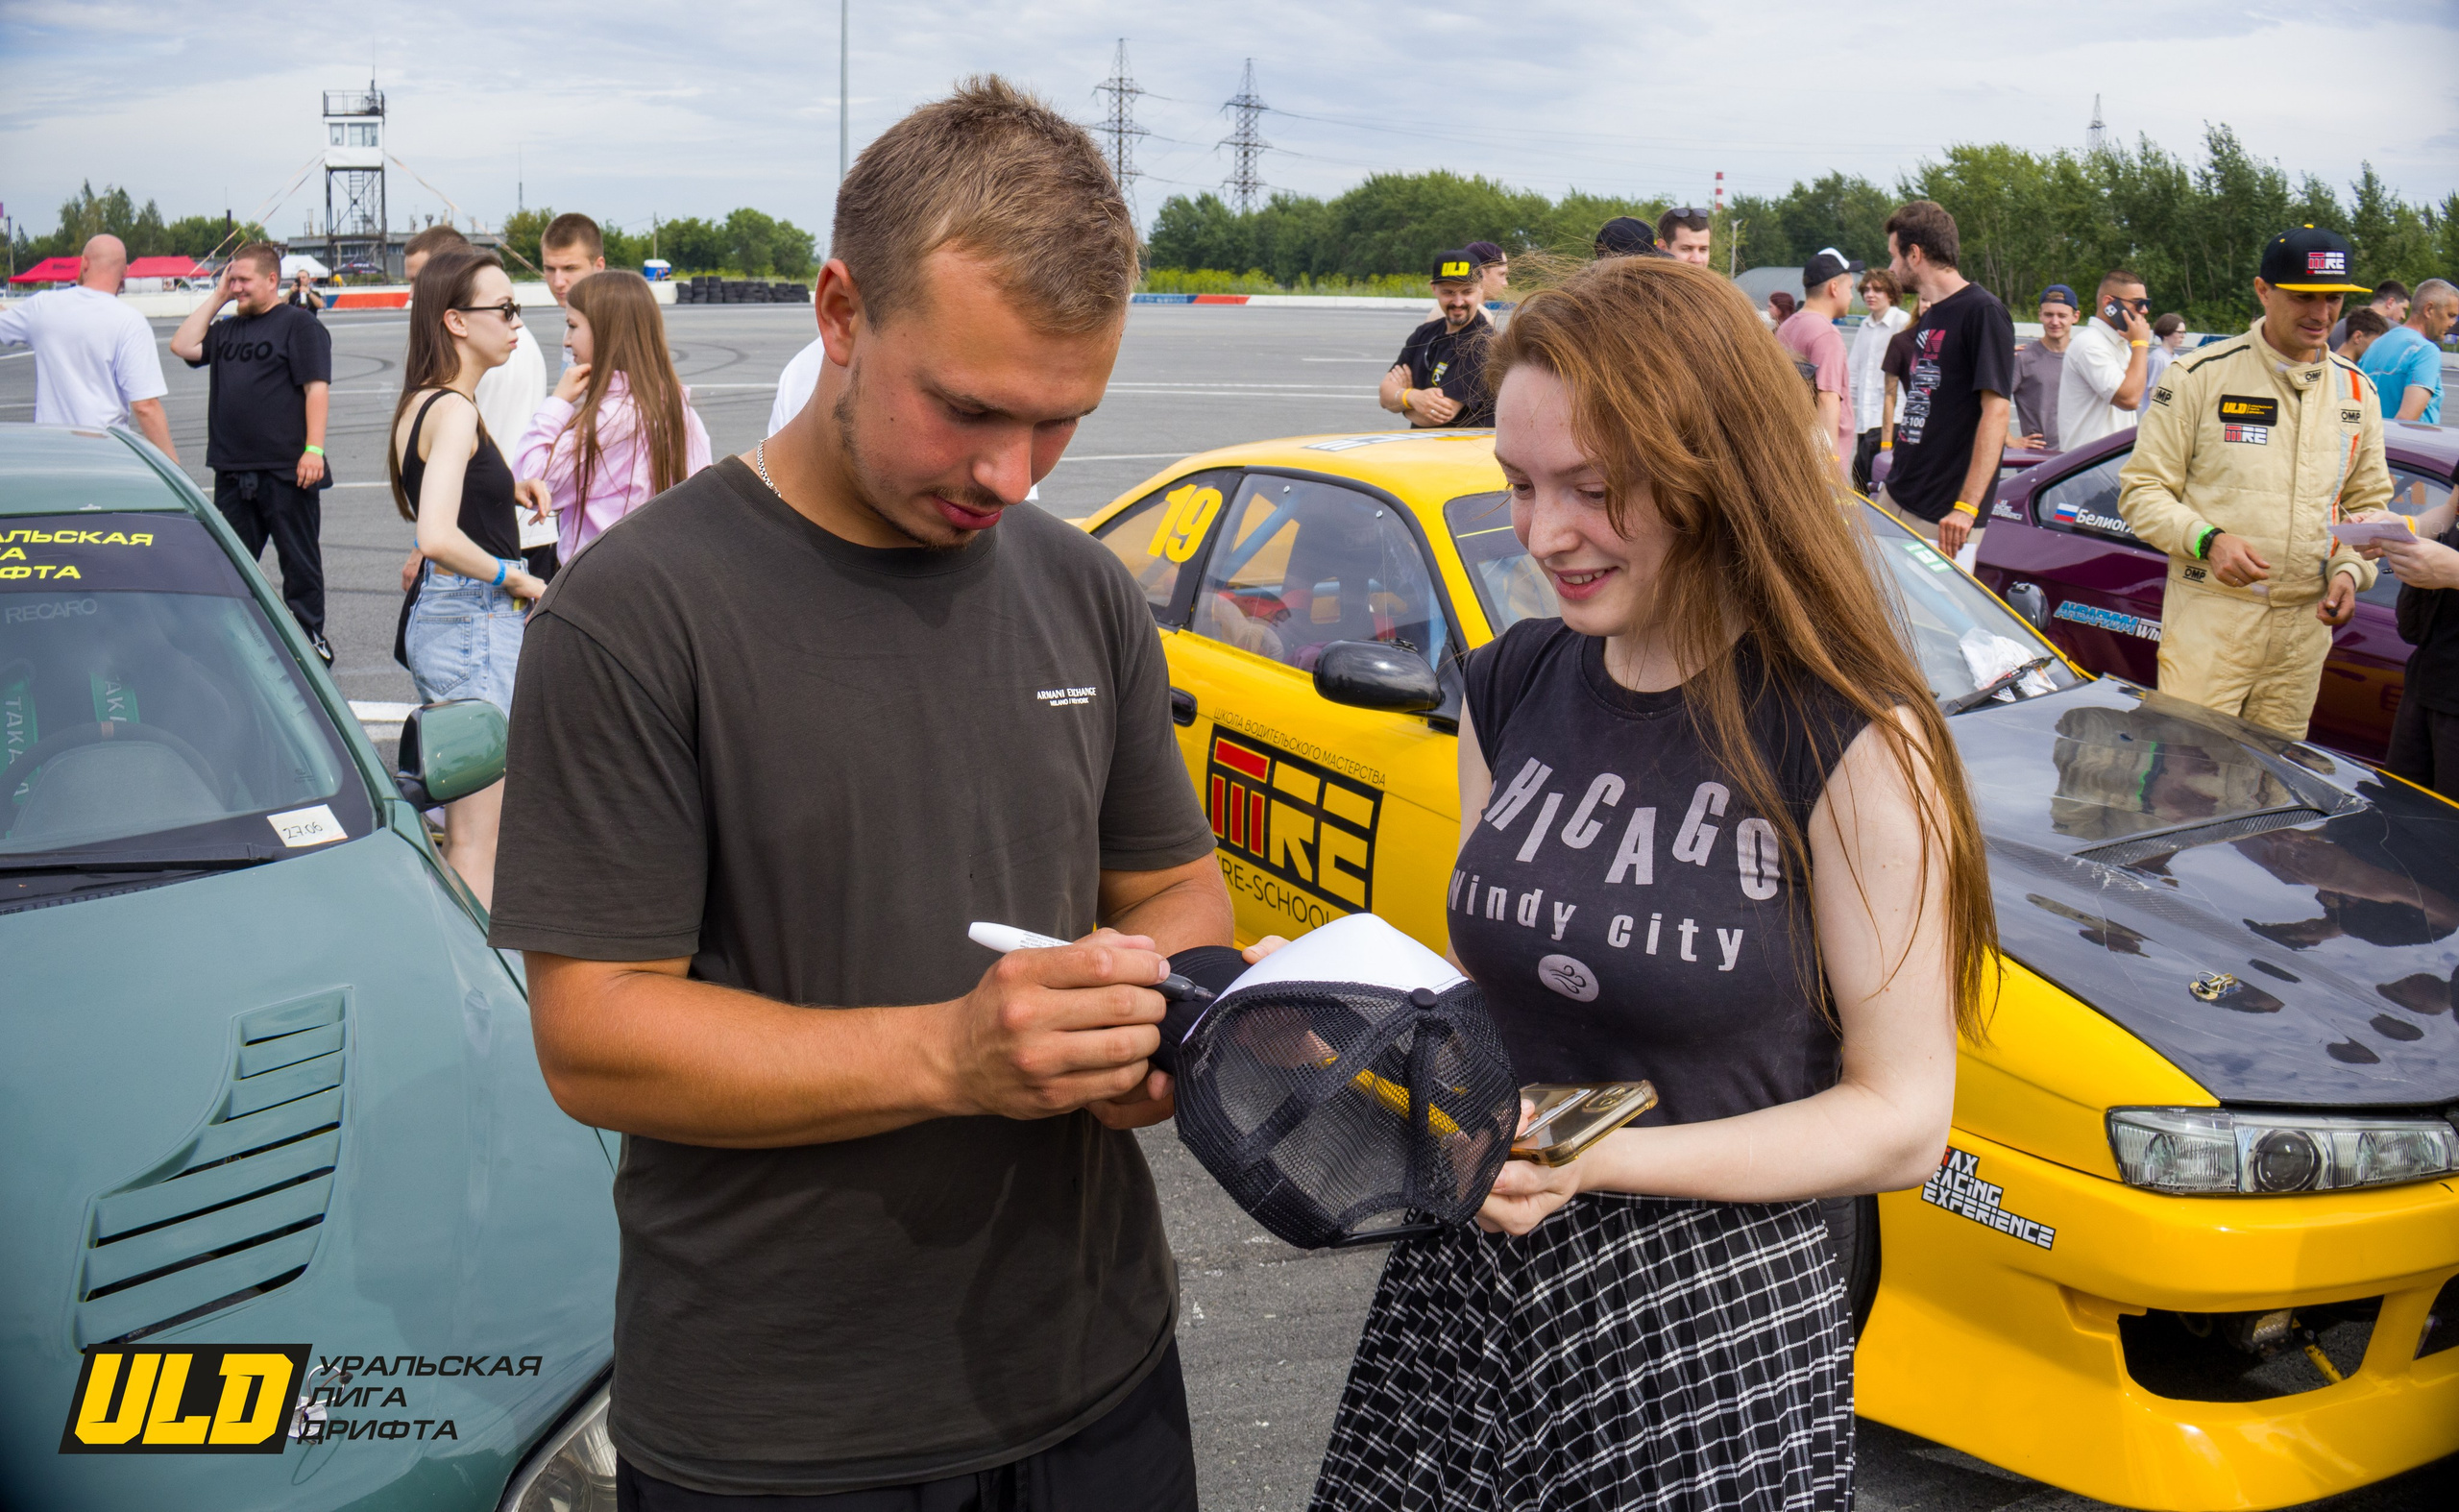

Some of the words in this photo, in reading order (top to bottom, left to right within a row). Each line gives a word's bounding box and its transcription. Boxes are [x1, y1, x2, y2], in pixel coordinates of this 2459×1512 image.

[1442, 261, 1470, 277] ULD
[2222, 402, 2248, 414] ULD
[2341, 411, 2361, 421] OMP
[1147, 483, 1223, 563] 19
[0, 530, 154, 546] ЛЬСКАЯ
[0, 565, 82, 579] ФТА
[2184, 568, 2206, 579] OMP
[5, 597, 98, 623] RECARO
[1037, 689, 1065, 700] ARMANI
[1066, 687, 1097, 697] EXCHANGE
[1214, 707, 1243, 728] ШКОЛА
[1245, 719, 1321, 760] ВОДИТЕЛЬСКОГО
[1323, 750, 1386, 787] МАСТЕРСТВА
[282, 821, 324, 841] 27.06
[1484, 757, 1780, 900] HICAGO
[1448, 868, 1577, 941] Windy
[1607, 913, 1744, 971] city
